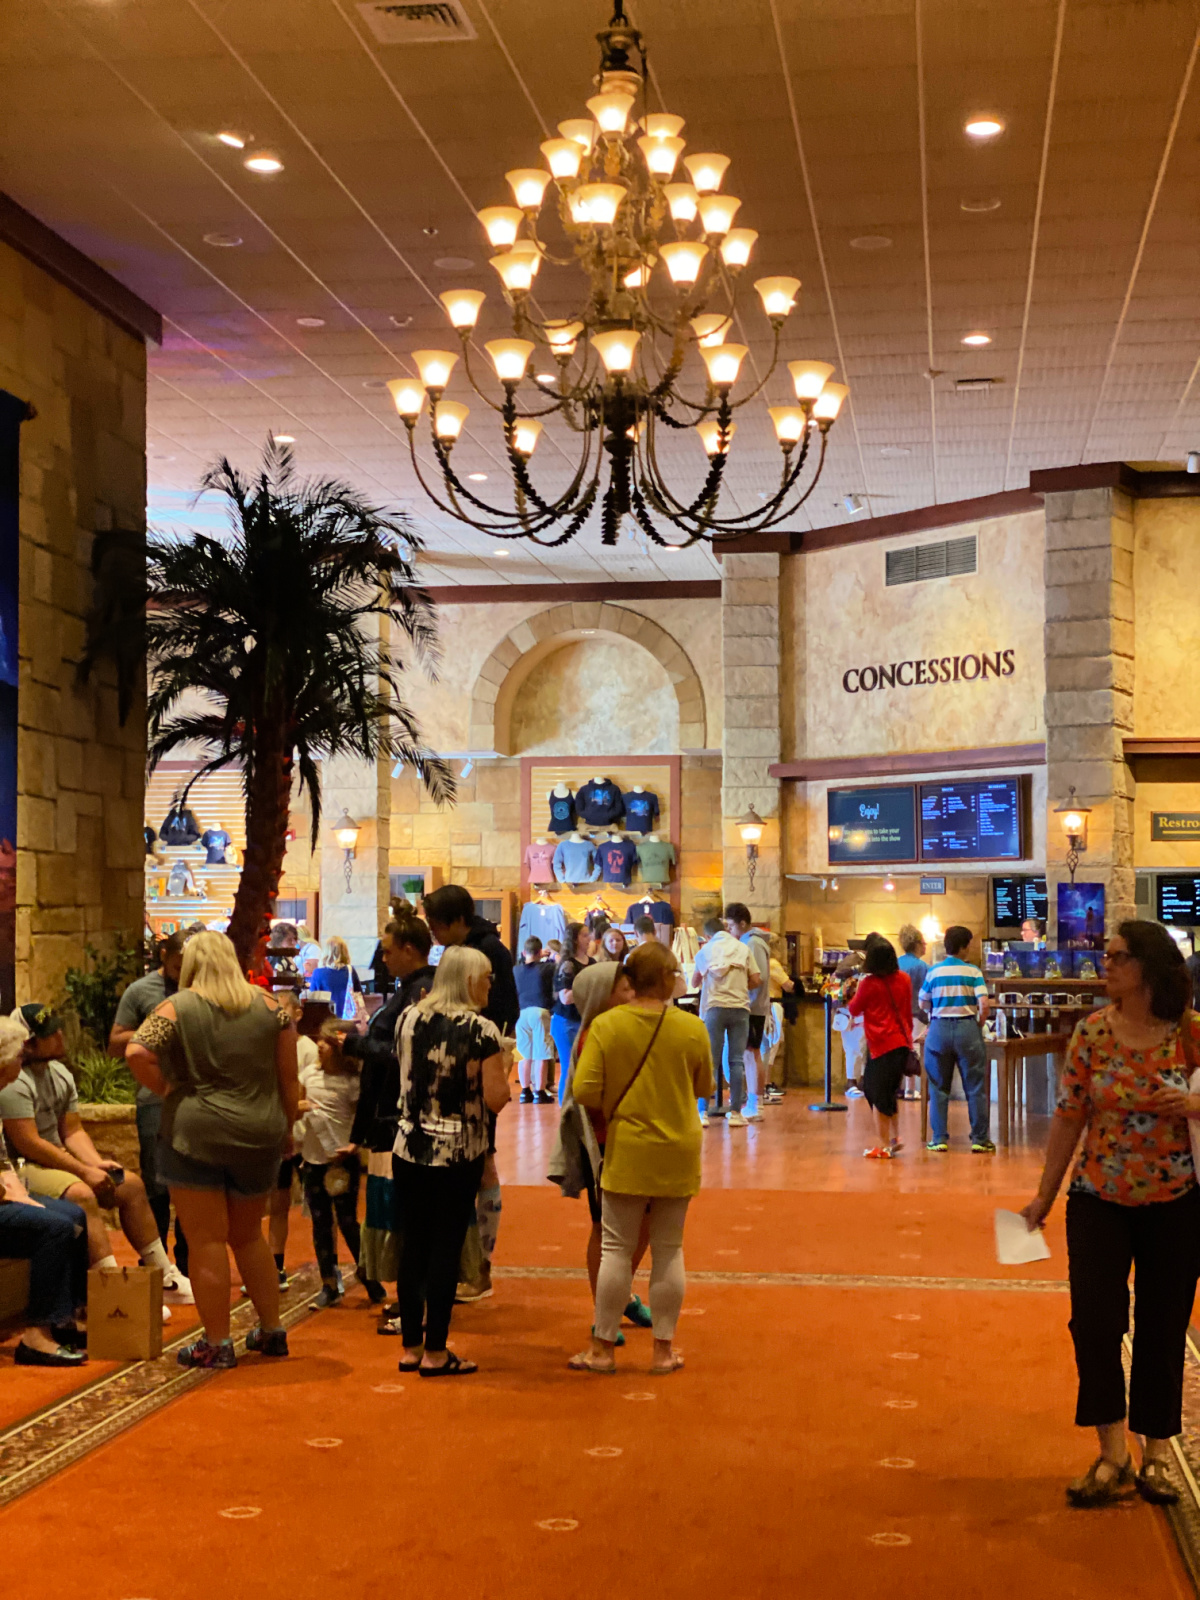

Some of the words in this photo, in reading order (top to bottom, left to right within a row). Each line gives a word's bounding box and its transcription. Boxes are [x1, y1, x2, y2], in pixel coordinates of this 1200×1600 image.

[842, 649, 1015, 693] CONCESSIONS
[859, 803, 879, 819] Enjoy!
[1158, 816, 1200, 828] Restro
[889, 828, 900, 836] your
[922, 882, 942, 890] ENTER
